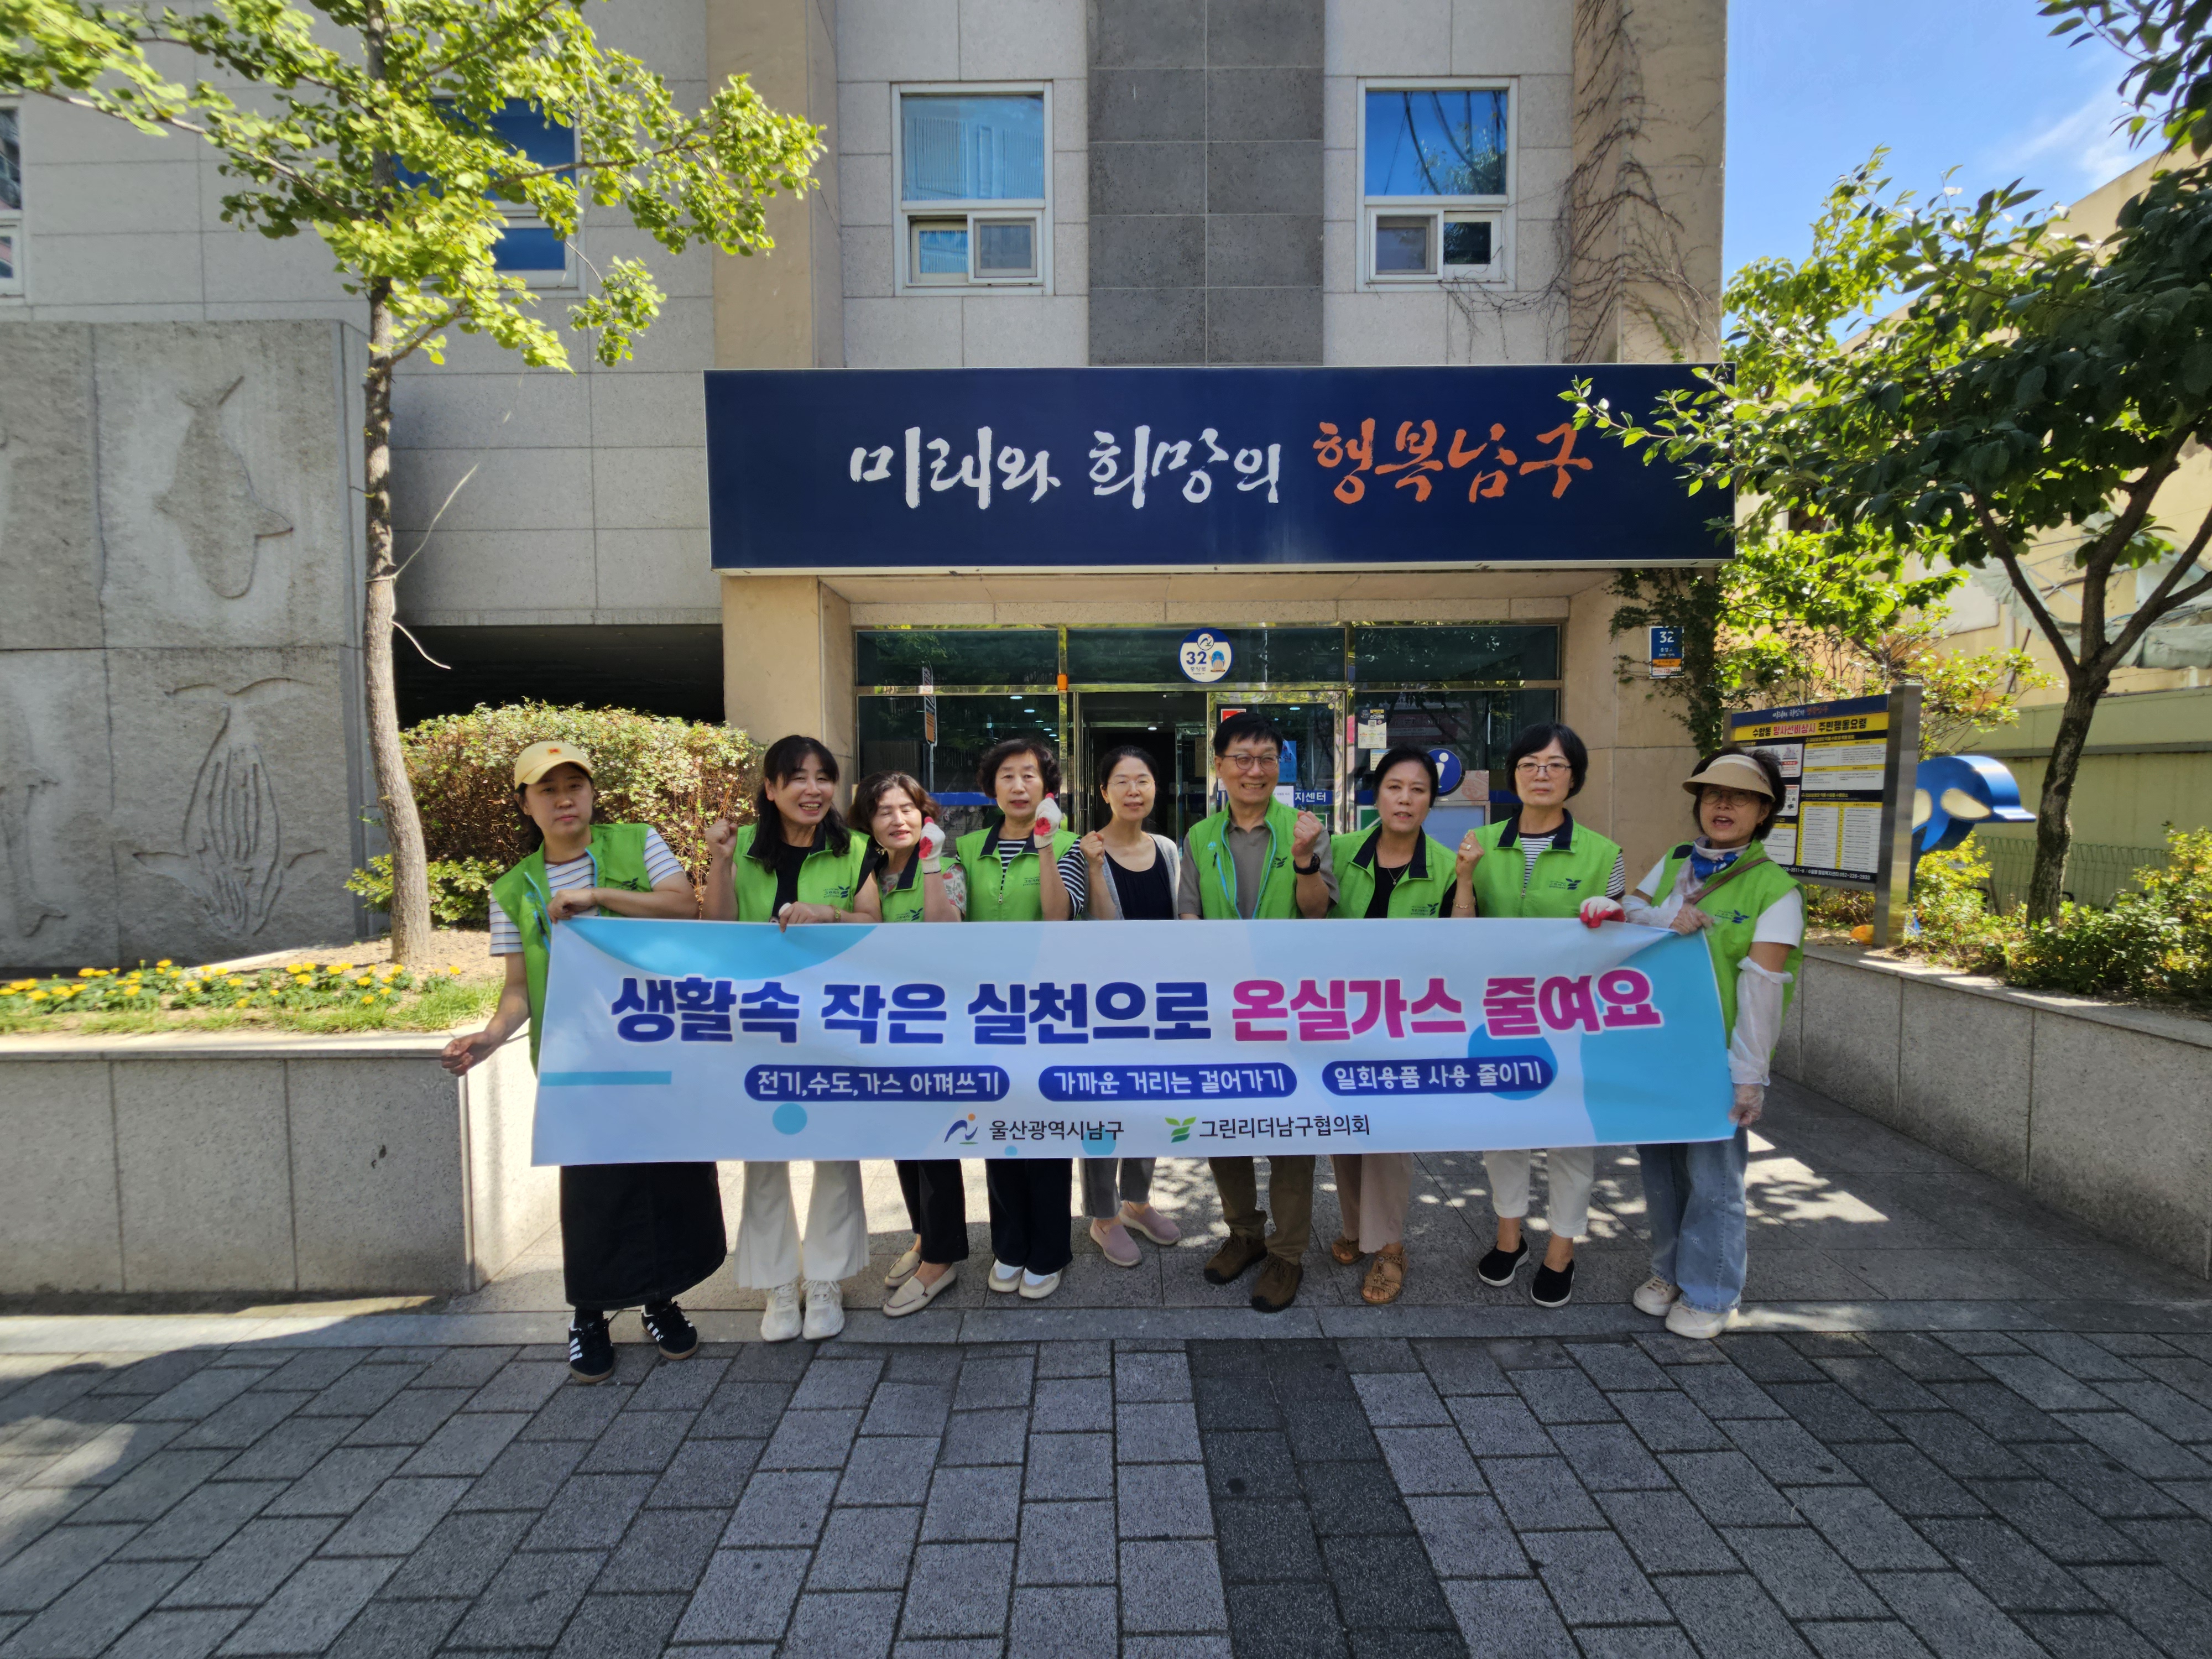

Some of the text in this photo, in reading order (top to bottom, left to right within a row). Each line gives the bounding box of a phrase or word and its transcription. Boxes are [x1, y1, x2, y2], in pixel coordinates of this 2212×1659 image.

[851, 418, 1593, 510] 미래와 희망의 행복남구
[1660, 631, 1674, 643] 32
[1186, 651, 1207, 665] 32
[1295, 792, 1326, 802] 지센터
[611, 970, 1661, 1045] 생활속 작은 실천으로 온실가스 줄여요
[758, 1071, 999, 1097] 전기,수도,가스 아껴쓰기
[1053, 1069, 1285, 1094] 가까운 거리는 걸어가기
[1334, 1061, 1541, 1090] 일회용품 사용 줄이기
[989, 1120, 1124, 1141] 울산광역시남구
[1199, 1114, 1370, 1139] 그린리더남구협의회
